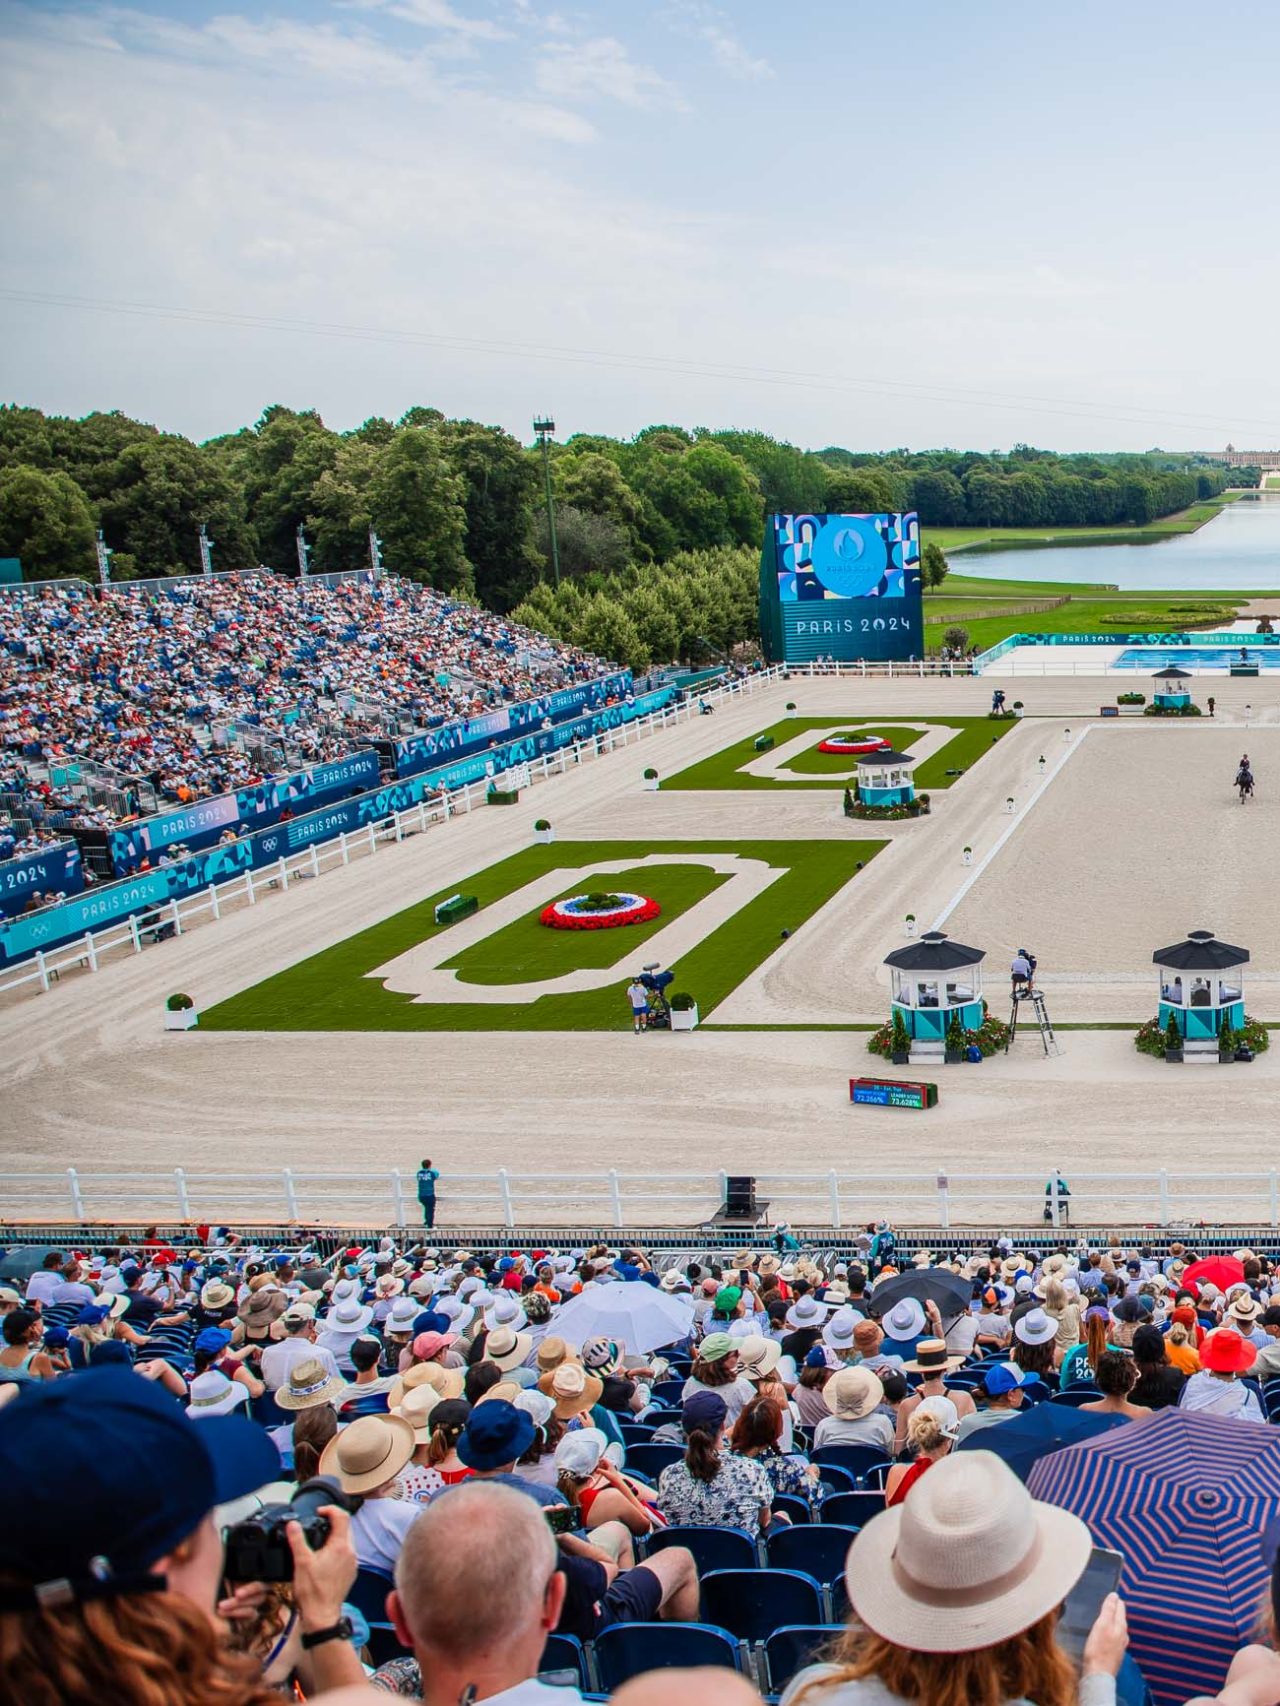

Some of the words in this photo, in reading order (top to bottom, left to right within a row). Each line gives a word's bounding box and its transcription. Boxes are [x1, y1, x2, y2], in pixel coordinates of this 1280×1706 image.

[796, 619, 853, 635] PARIS
[861, 617, 910, 632] 2024
[1062, 634, 1089, 643] PARIS
[1092, 635, 1116, 643] 2024
[1203, 635, 1229, 644] PARIS
[572, 691, 587, 703] 2024
[323, 767, 348, 785] PARIS
[349, 760, 372, 776] 2024
[161, 815, 196, 838] PARIS
[198, 807, 228, 826] 2024
[297, 820, 324, 840] PARIS
[325, 812, 348, 829] 2024
[6, 864, 47, 889] 2024
[82, 897, 119, 921] PARIS
[122, 884, 155, 905] 2024
[892, 1097, 919, 1106] 73.628%
